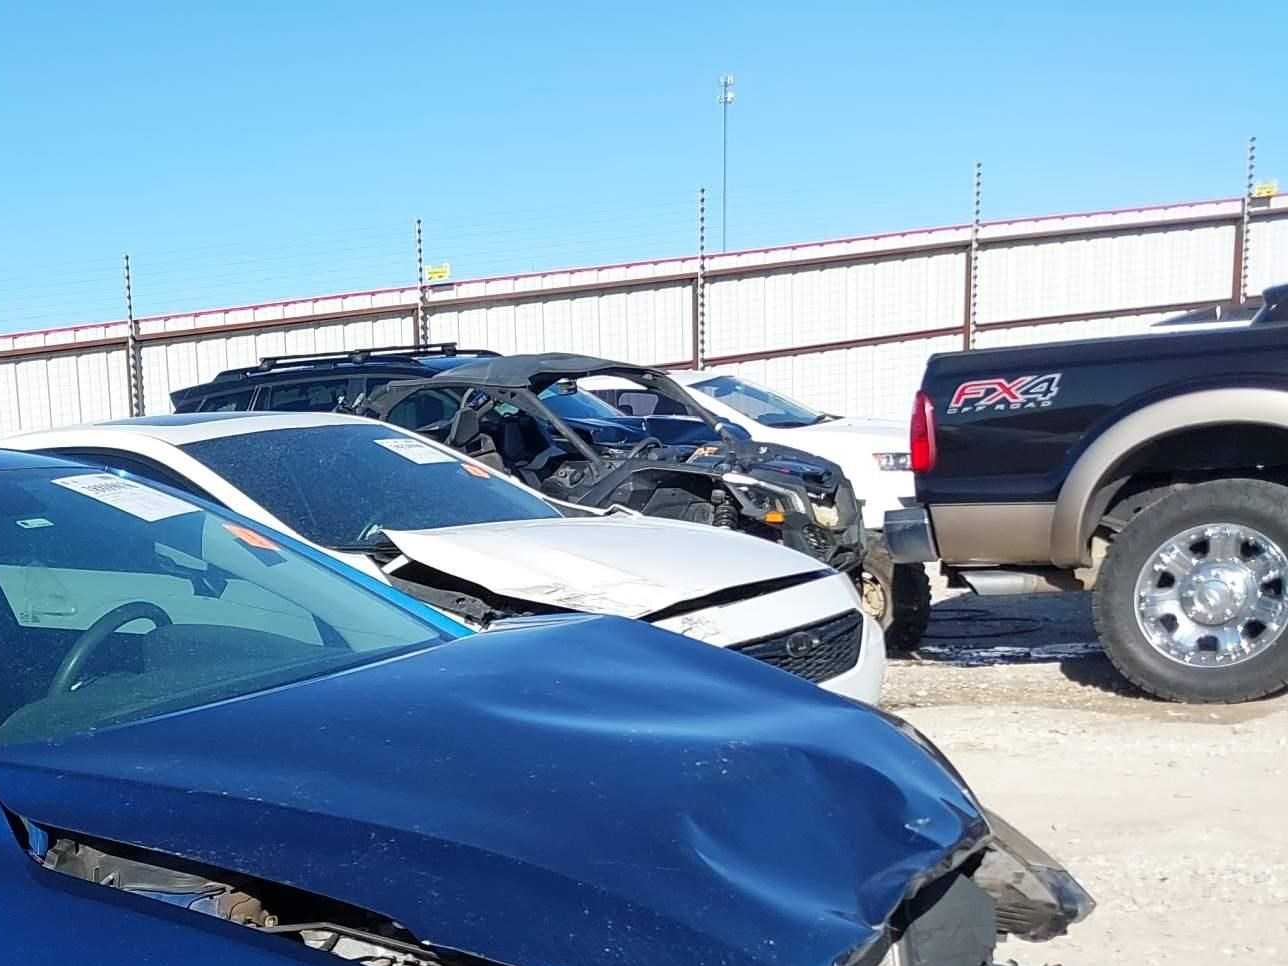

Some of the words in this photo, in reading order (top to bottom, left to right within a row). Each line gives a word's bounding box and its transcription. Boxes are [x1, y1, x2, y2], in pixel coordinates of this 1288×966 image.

[949, 373, 1063, 408] FX4
[947, 404, 986, 415] OFF
[994, 400, 1053, 411] ROAD
